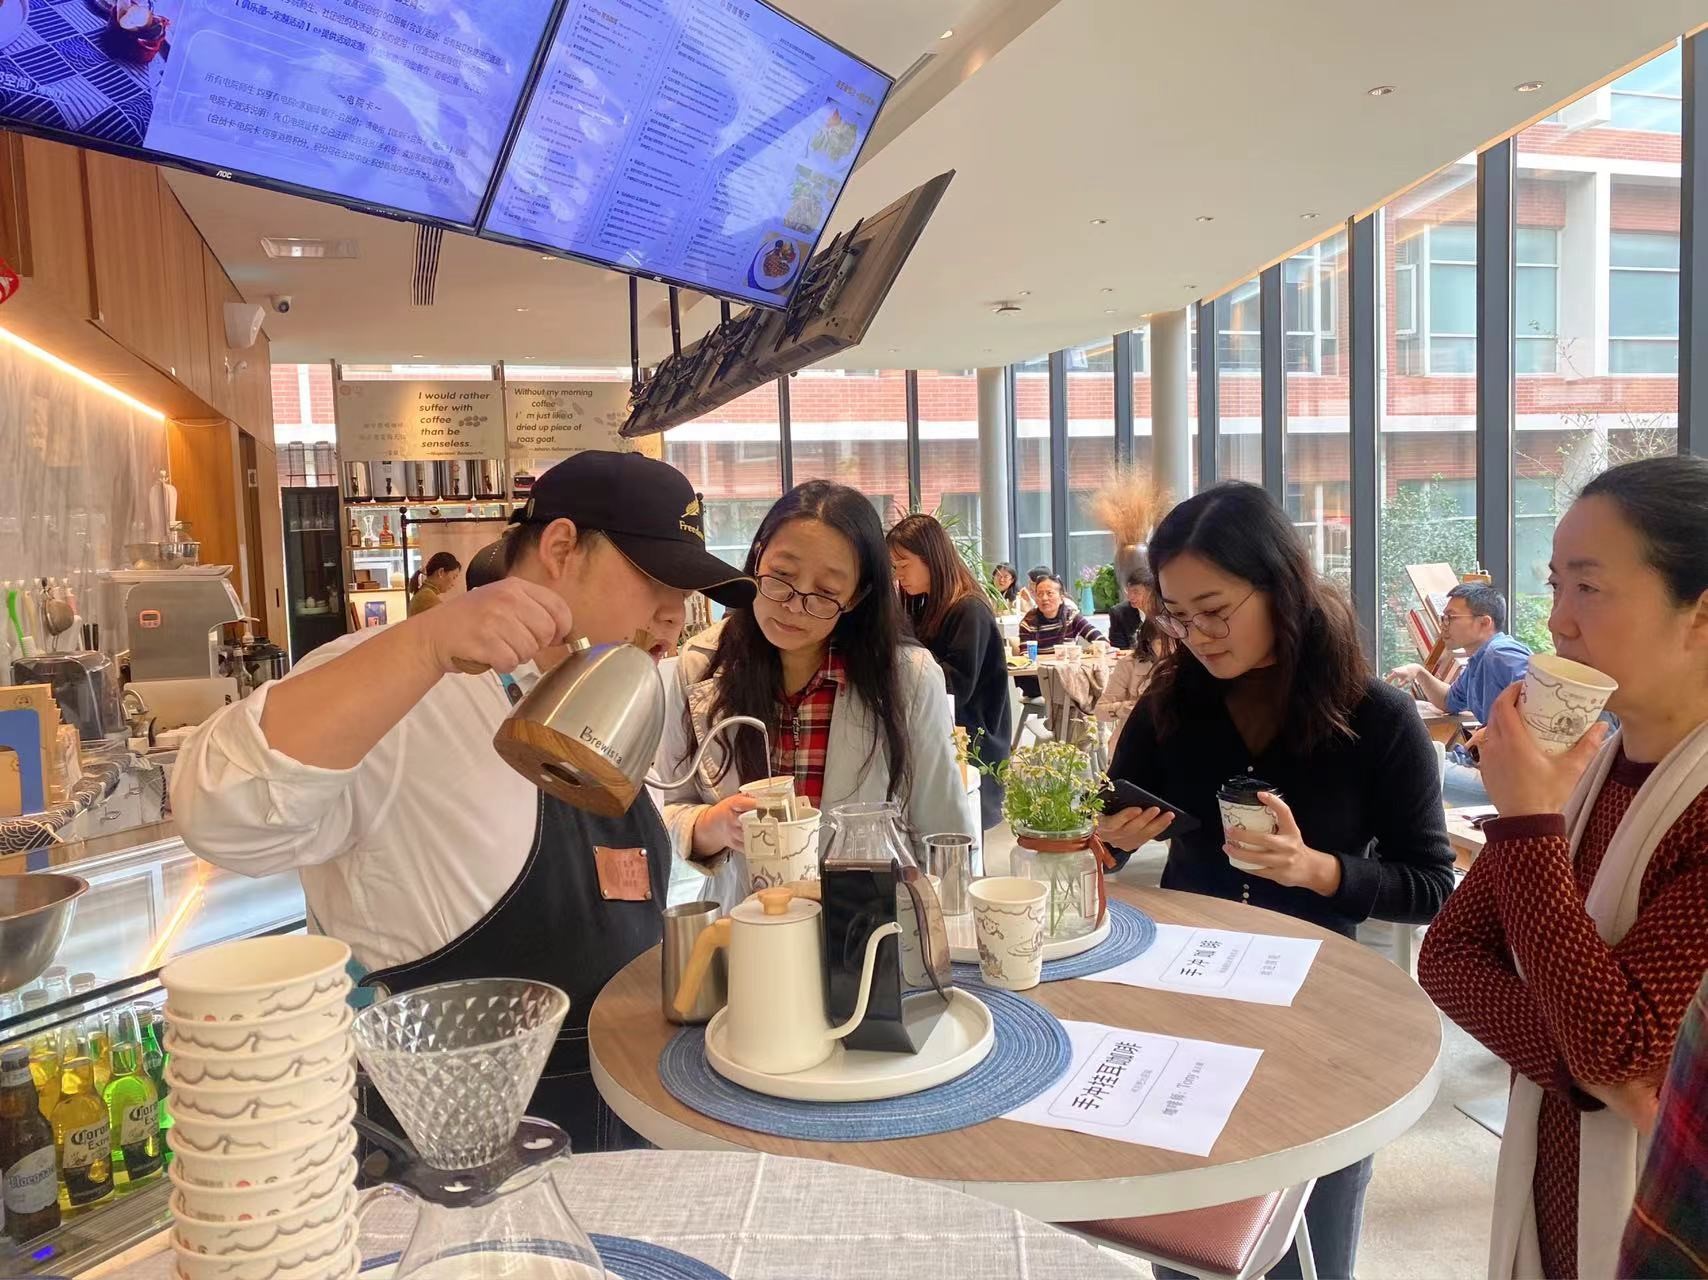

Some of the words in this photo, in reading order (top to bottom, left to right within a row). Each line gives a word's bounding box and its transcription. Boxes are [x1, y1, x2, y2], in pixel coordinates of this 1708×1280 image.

[425, 392, 456, 400] would
[459, 392, 490, 400] rather
[514, 388, 545, 396] Without
[546, 389, 558, 398] my
[560, 389, 593, 398] morning
[419, 404, 448, 412] suffer
[452, 404, 473, 412] with
[420, 416, 452, 424] coffee
[536, 412, 551, 421] just
[421, 428, 444, 436] than
[447, 428, 460, 436] be
[516, 423, 537, 431] dried
[539, 424, 549, 433] up
[551, 423, 572, 434] piece
[573, 423, 582, 431] of
[421, 440, 472, 448] senseless.
[579, 725, 623, 765] Brewista
[1072, 1041, 1143, 1110] 手冲挂耳咖啡
